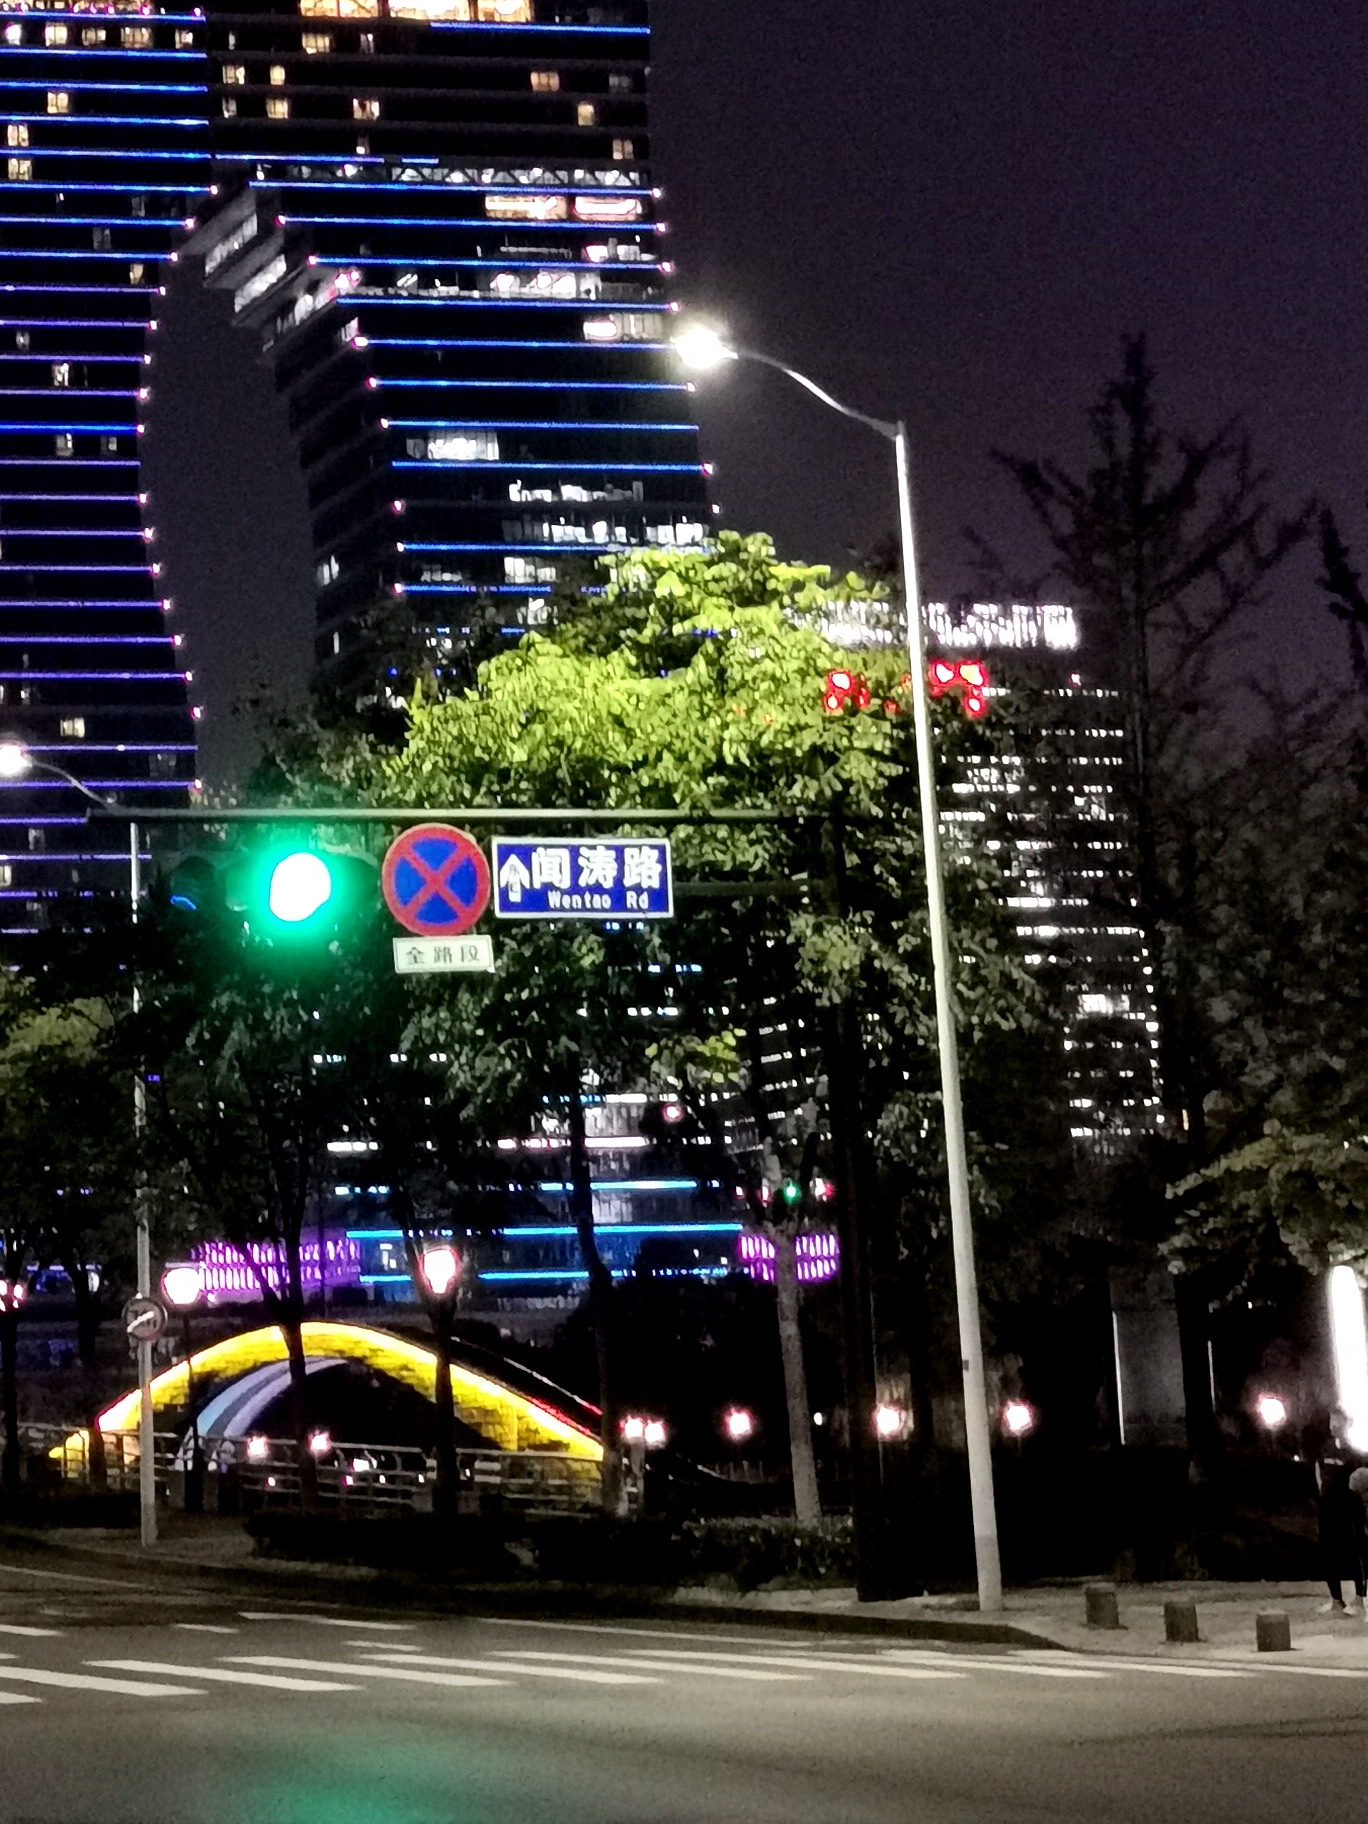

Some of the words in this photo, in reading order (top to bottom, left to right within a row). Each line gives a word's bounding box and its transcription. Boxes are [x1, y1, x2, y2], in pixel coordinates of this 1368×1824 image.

[532, 845, 662, 889] 闻涛路
[547, 890, 612, 910] Wentao
[626, 890, 649, 910] Rd
